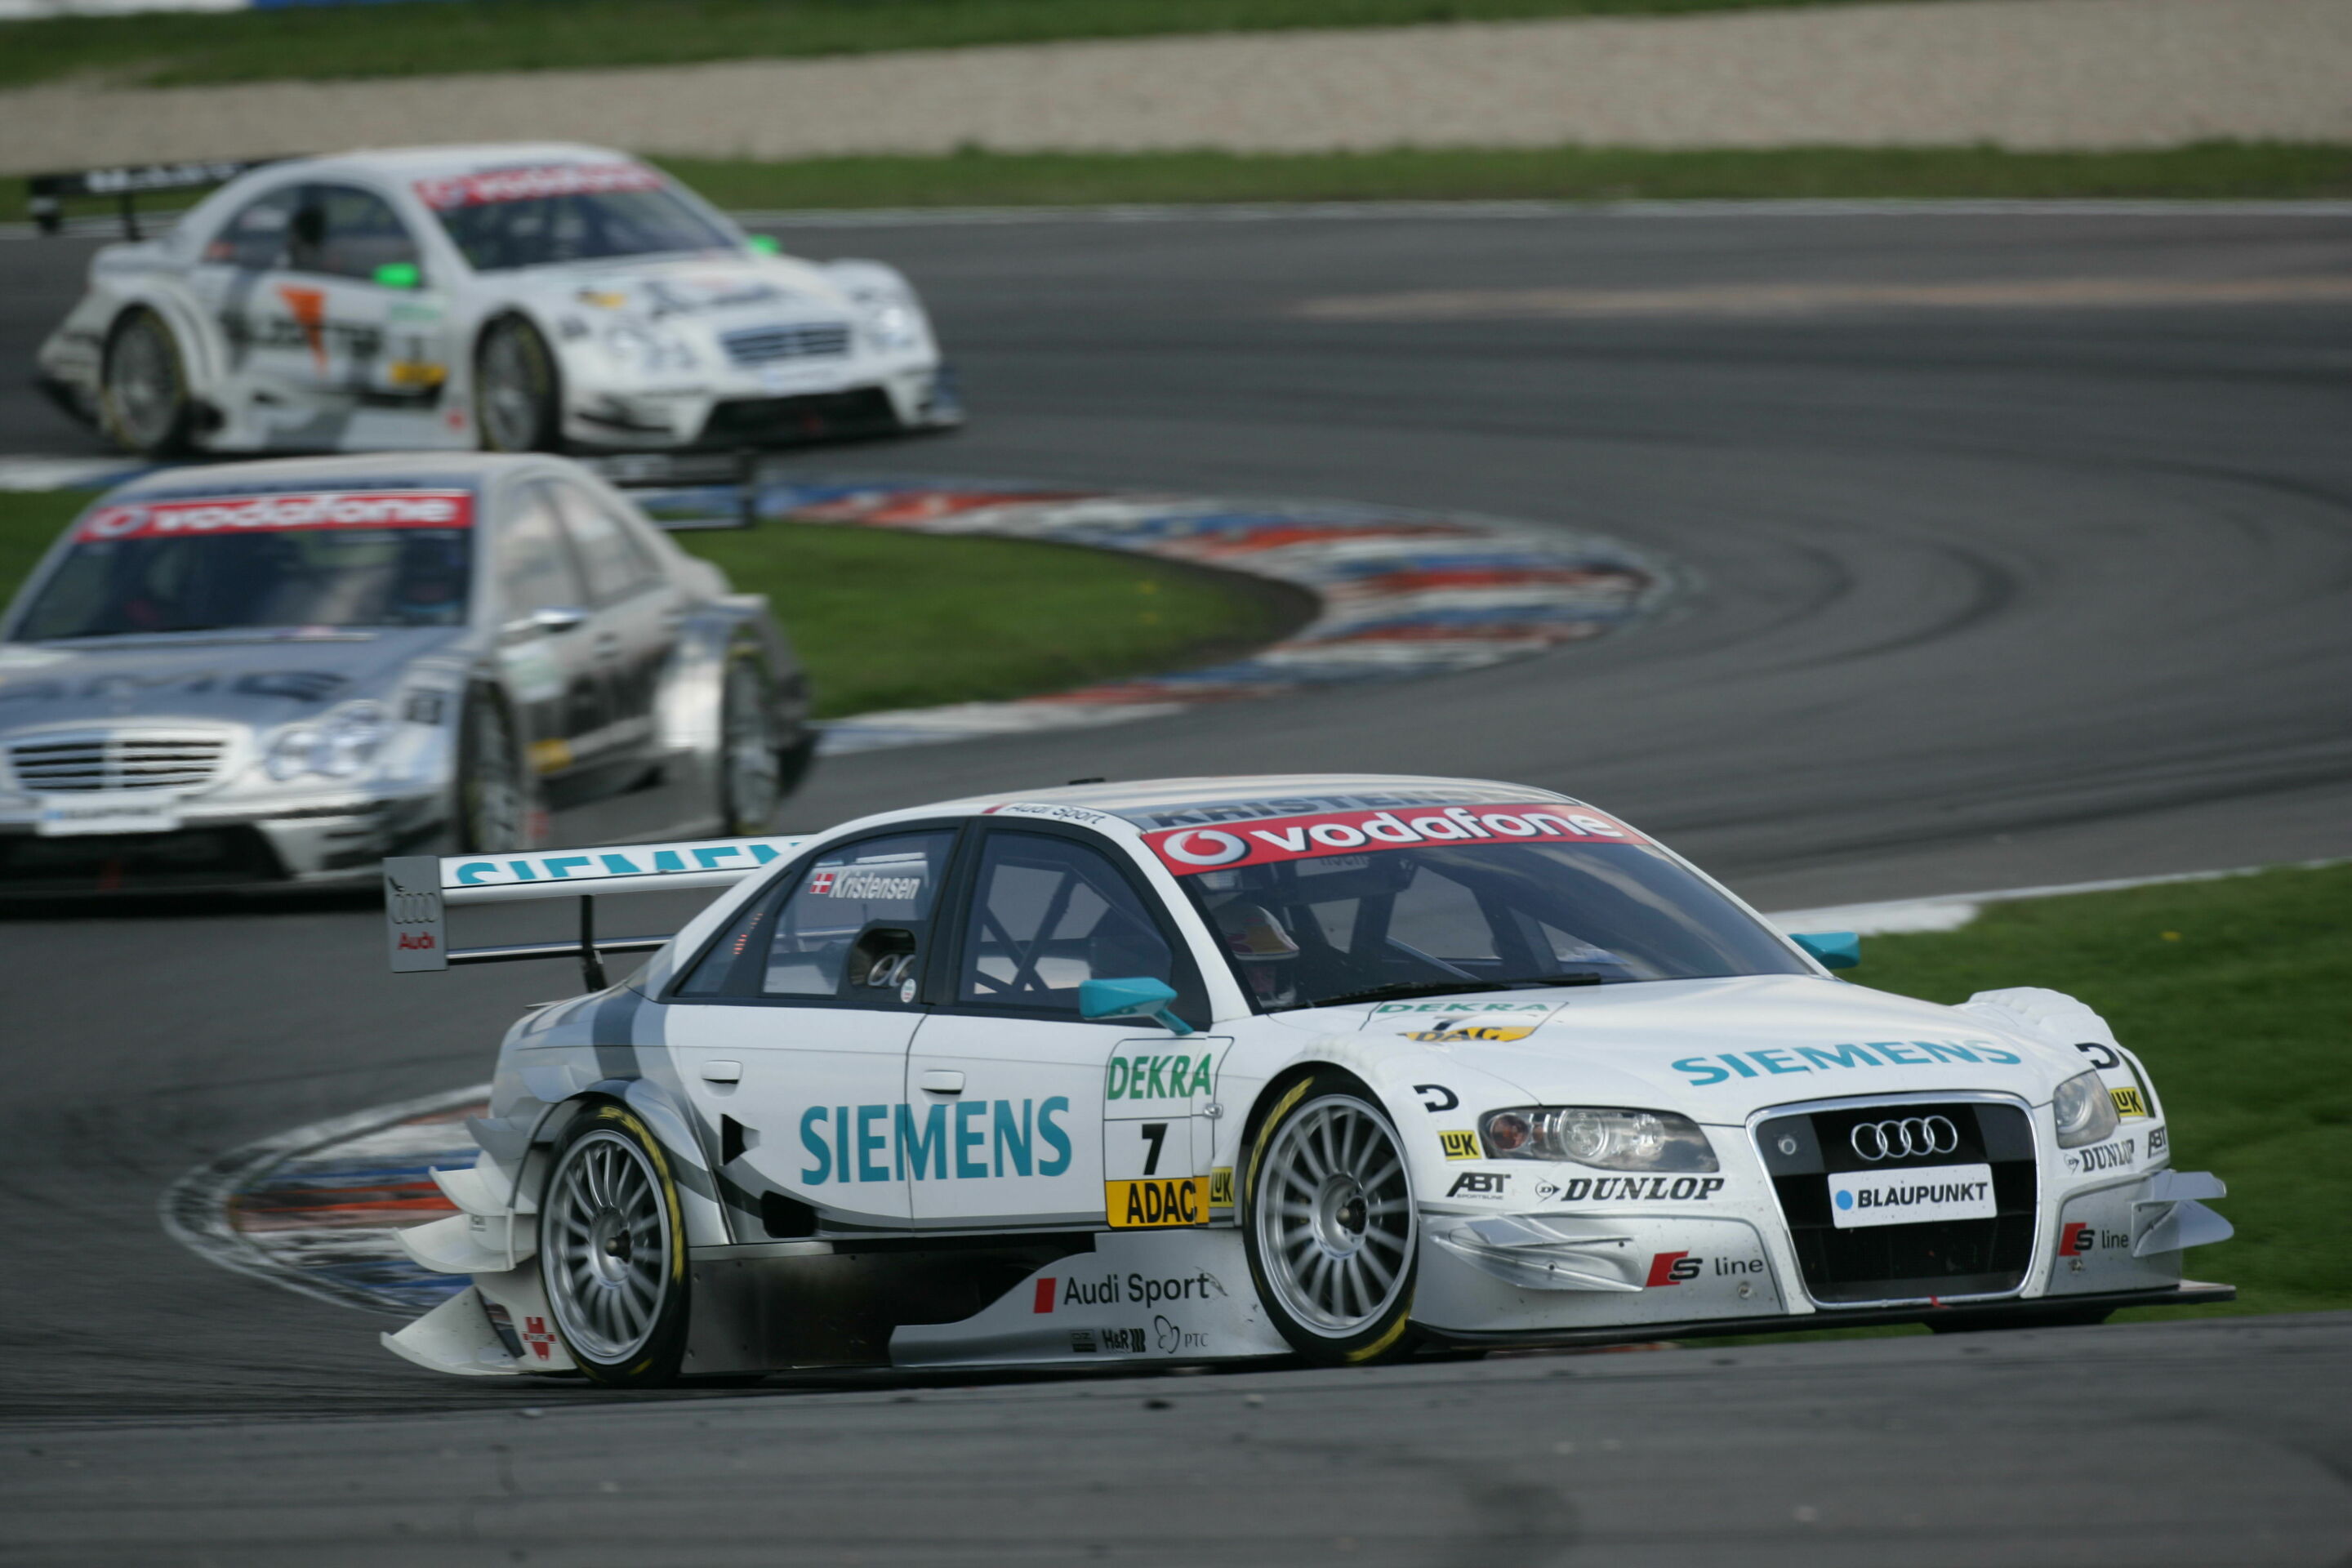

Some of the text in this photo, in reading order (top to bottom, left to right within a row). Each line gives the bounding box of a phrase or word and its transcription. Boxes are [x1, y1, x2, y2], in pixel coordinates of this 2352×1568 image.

[154, 493, 458, 531] vodafone
[1250, 807, 1624, 852] vodafone
[828, 870, 921, 900] Kristensen
[397, 931, 436, 951] Audi
[1375, 1002, 1550, 1013] DEKRA
[1107, 1053, 1213, 1100] DEKRA
[1671, 1039, 2022, 1087] SIEMENS
[799, 1095, 1072, 1186] SIEMENS
[1141, 1122, 1169, 1176] 7
[2079, 1138, 2135, 1173] DUNLOP
[1446, 1171, 1511, 1198] ABT
[1560, 1177, 1725, 1202] DUNLOP
[1857, 1182, 1989, 1209] BLAUPUNKT
[1126, 1180, 1197, 1224] ADAC
[2074, 1229, 2129, 1250] S line
[1668, 1257, 1764, 1281] S line
[1063, 1272, 1209, 1308] Audi Sport
[1102, 1329, 1130, 1350] H&R
[1184, 1332, 1209, 1348] PTC
